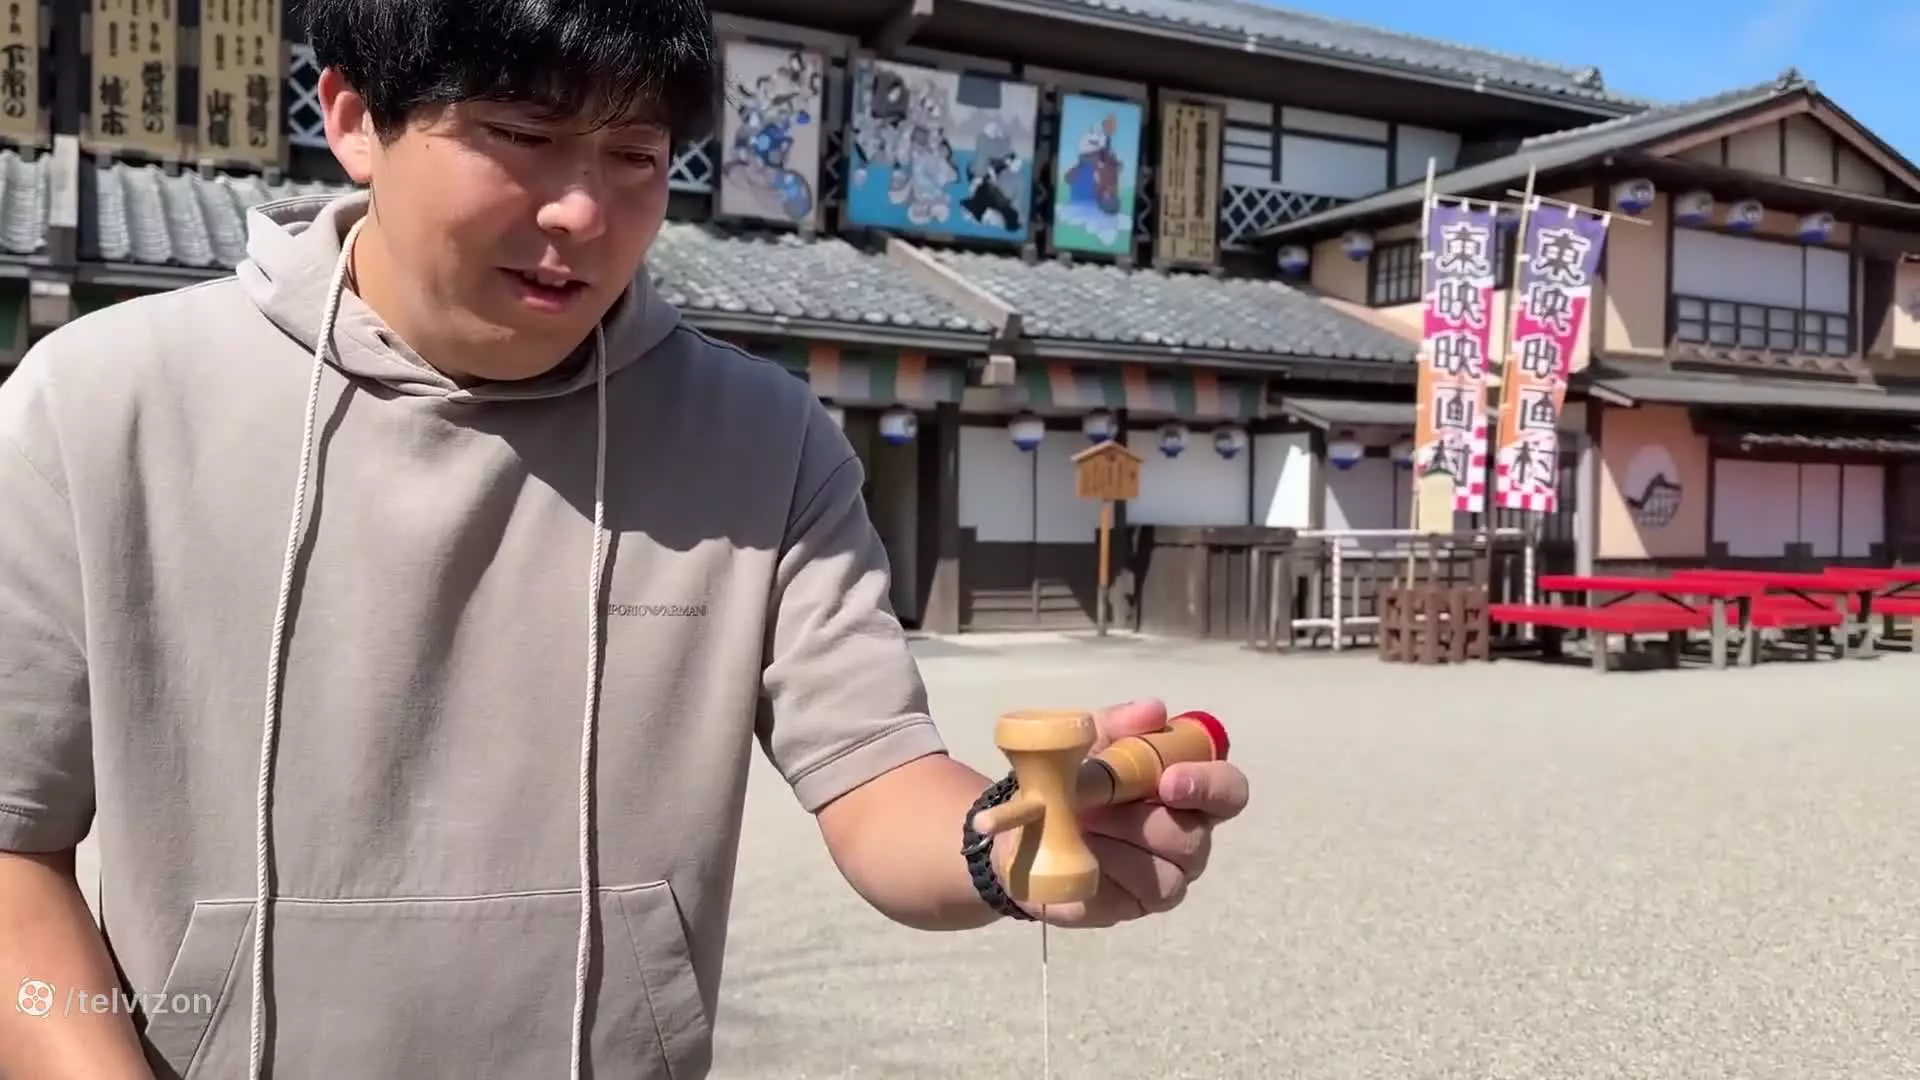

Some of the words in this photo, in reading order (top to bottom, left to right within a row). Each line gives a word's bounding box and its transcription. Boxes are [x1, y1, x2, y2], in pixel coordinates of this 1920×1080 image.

[207, 88, 236, 147] 山
[1431, 222, 1491, 488] 東映映画村
[1510, 230, 1591, 490] 東映映画村
